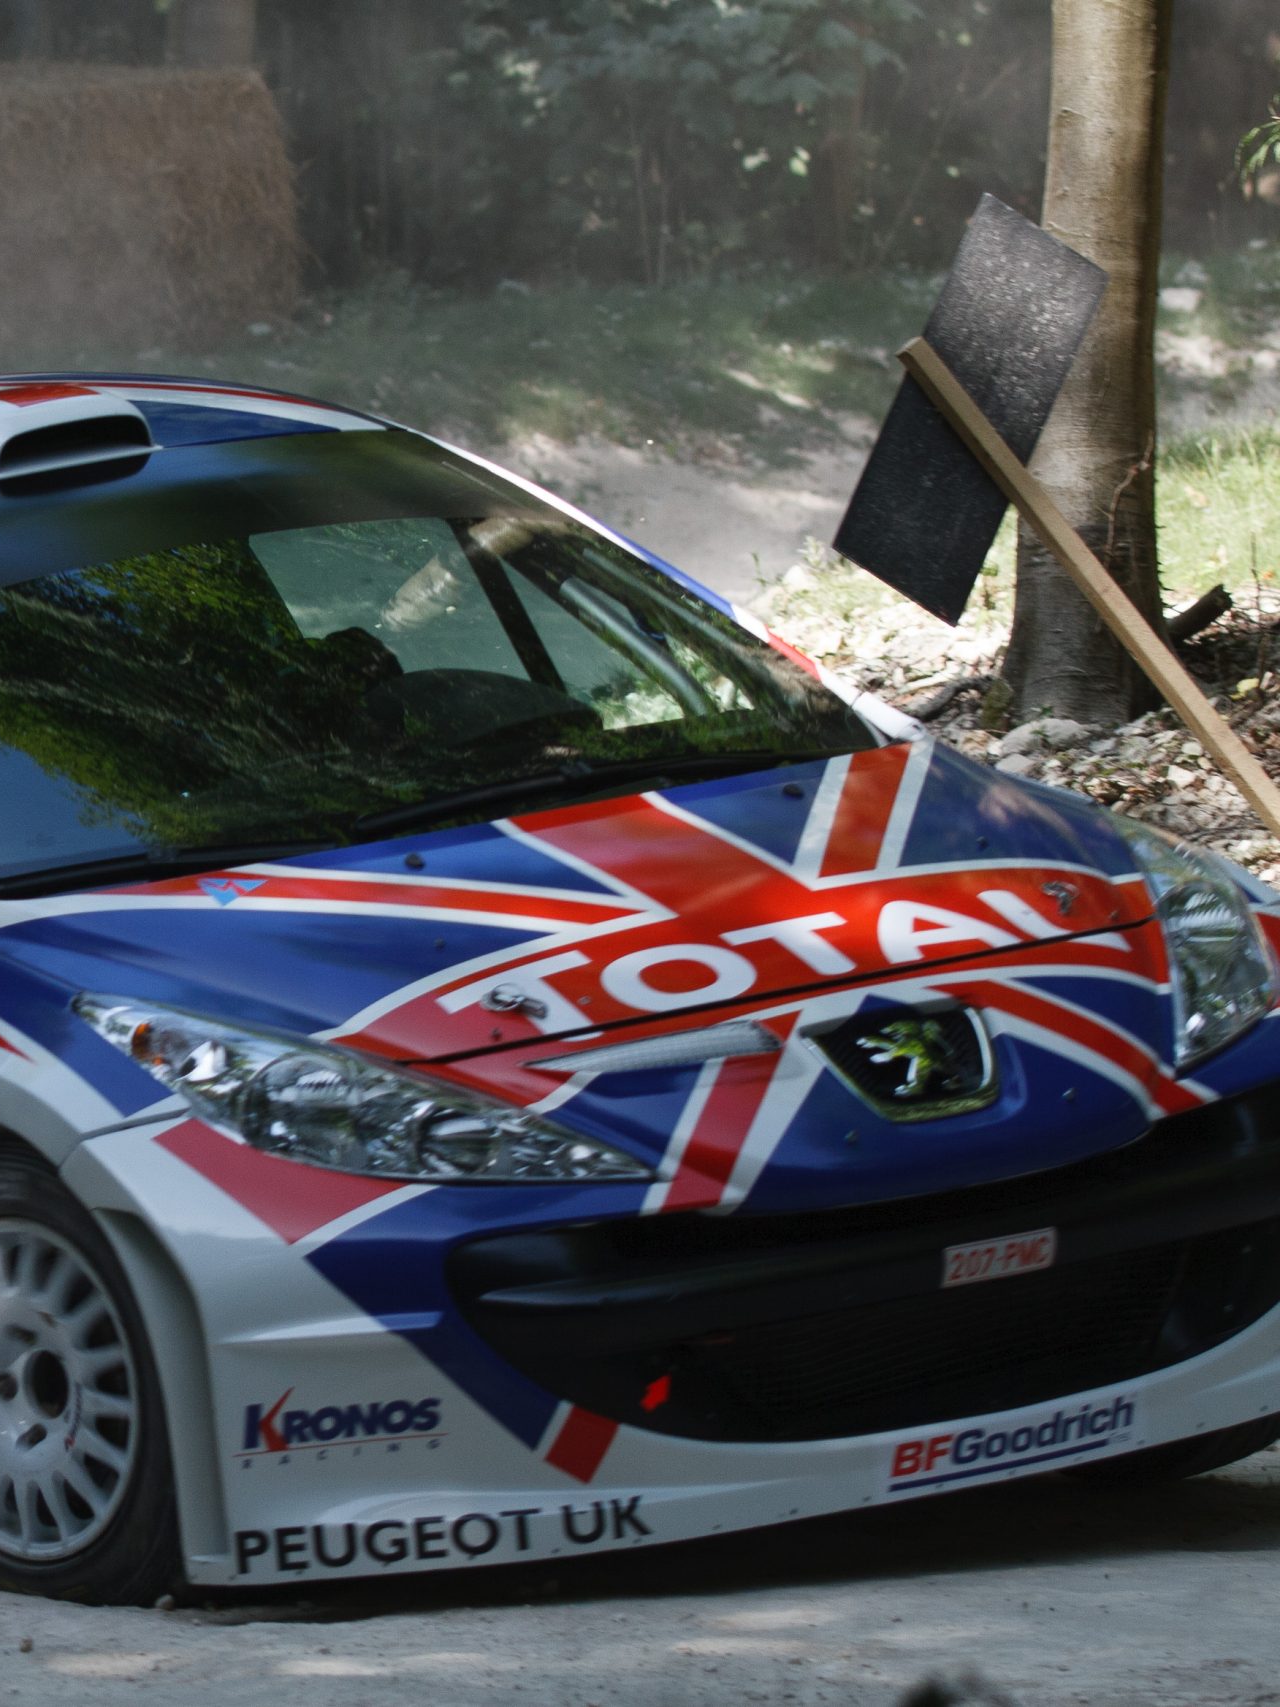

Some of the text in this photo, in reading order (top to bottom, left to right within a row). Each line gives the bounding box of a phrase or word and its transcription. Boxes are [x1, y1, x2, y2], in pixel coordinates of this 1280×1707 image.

[436, 890, 1132, 1043] TOTAL
[242, 1386, 443, 1452] KRONOS
[891, 1397, 1136, 1478] BFGoodrich
[235, 1496, 652, 1575] PEUGEOT UK
